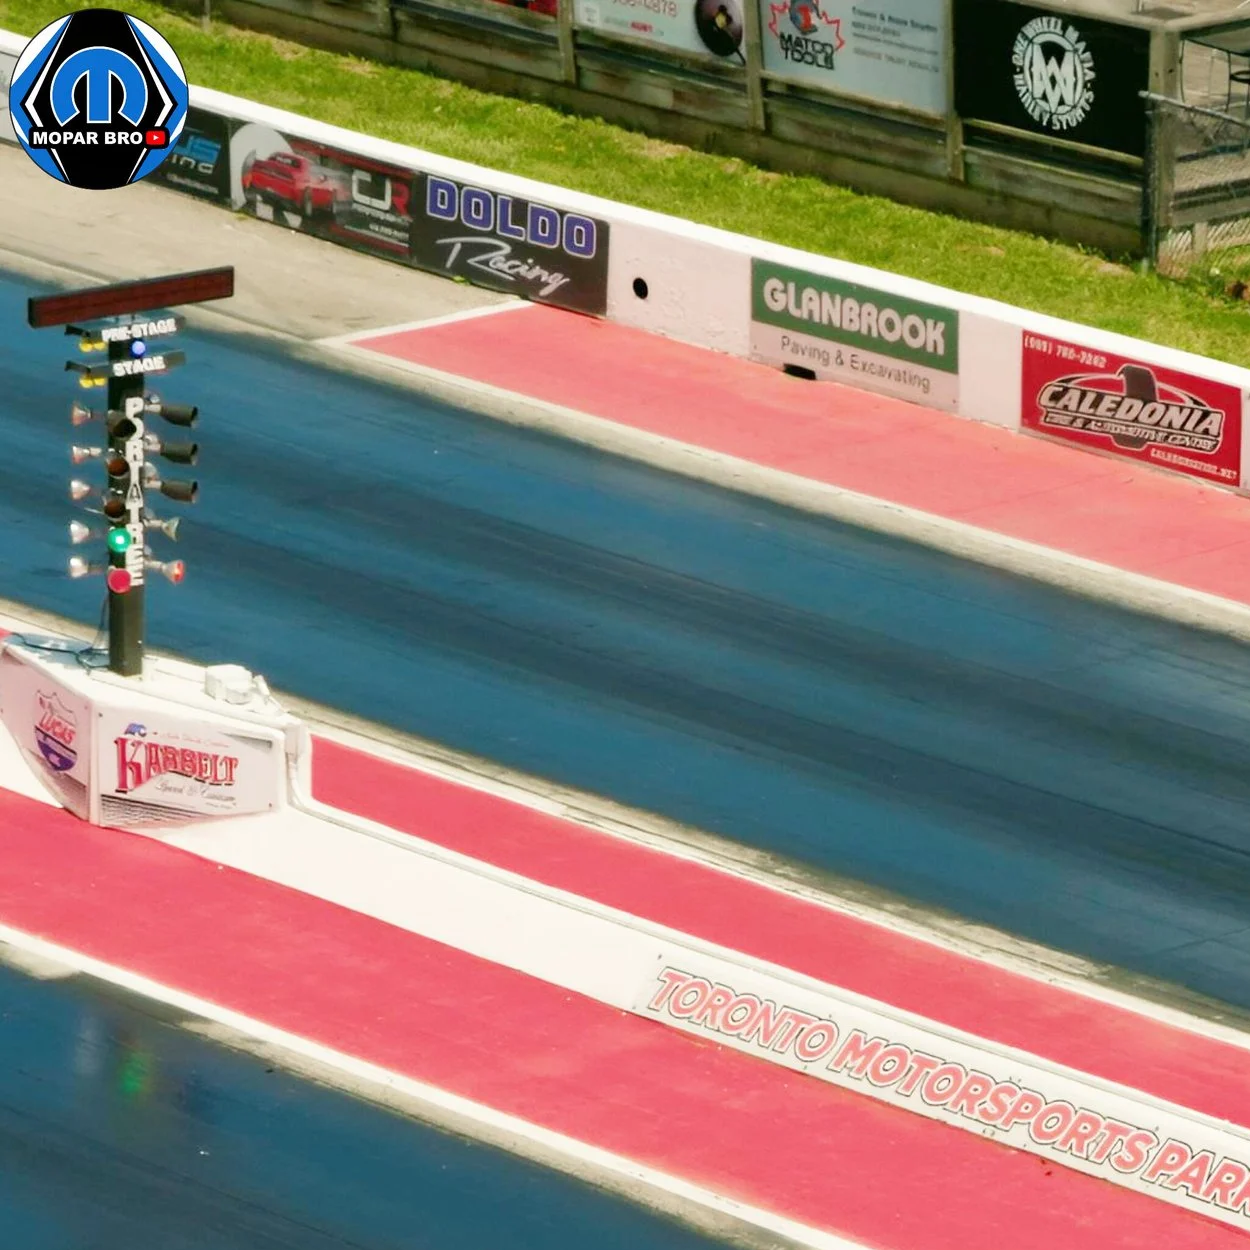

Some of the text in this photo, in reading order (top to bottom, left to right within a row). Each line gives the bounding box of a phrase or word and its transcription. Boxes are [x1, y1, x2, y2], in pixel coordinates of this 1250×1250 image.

[427, 175, 596, 259] DOLDO
[436, 236, 571, 297] Racing
[101, 318, 177, 342] PRE-STAGE
[764, 278, 945, 355] GLANBROOK
[113, 356, 166, 377] STAGE
[781, 336, 931, 394] Paving & Excavating
[1040, 384, 1222, 436] CALEDONIA
[648, 966, 839, 1062] TORONTO
[827, 1028, 1160, 1174] MOTORSPORTS
